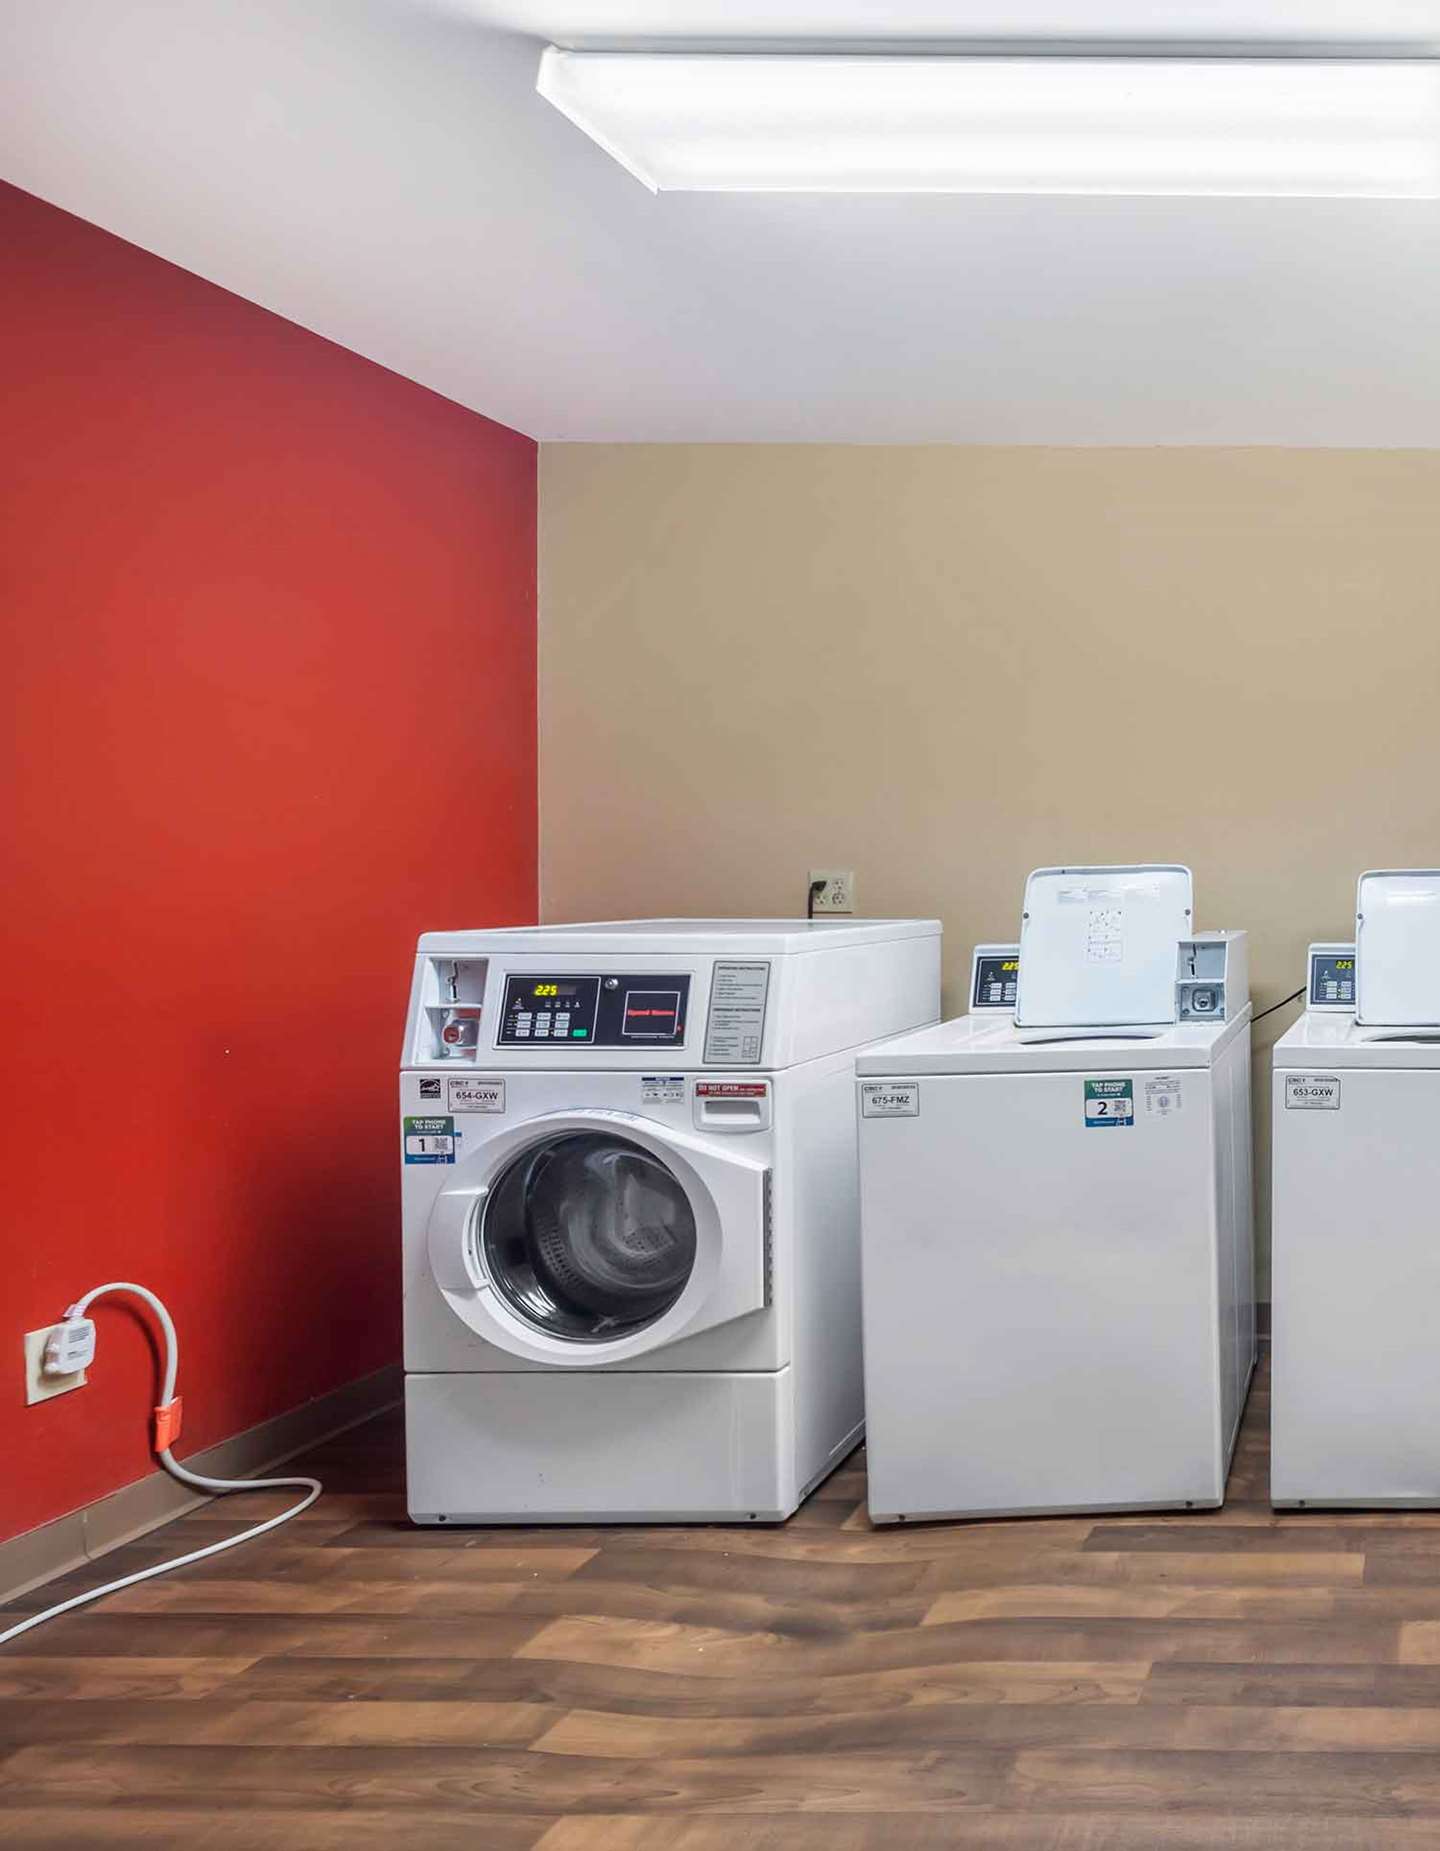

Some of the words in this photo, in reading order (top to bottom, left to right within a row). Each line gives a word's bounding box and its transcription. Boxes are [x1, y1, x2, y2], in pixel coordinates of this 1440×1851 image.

[456, 1092, 499, 1100] 654-GXW
[1293, 1088, 1334, 1096] 653-GXW
[1097, 1101, 1108, 1115] 2
[418, 1138, 425, 1152] 1
